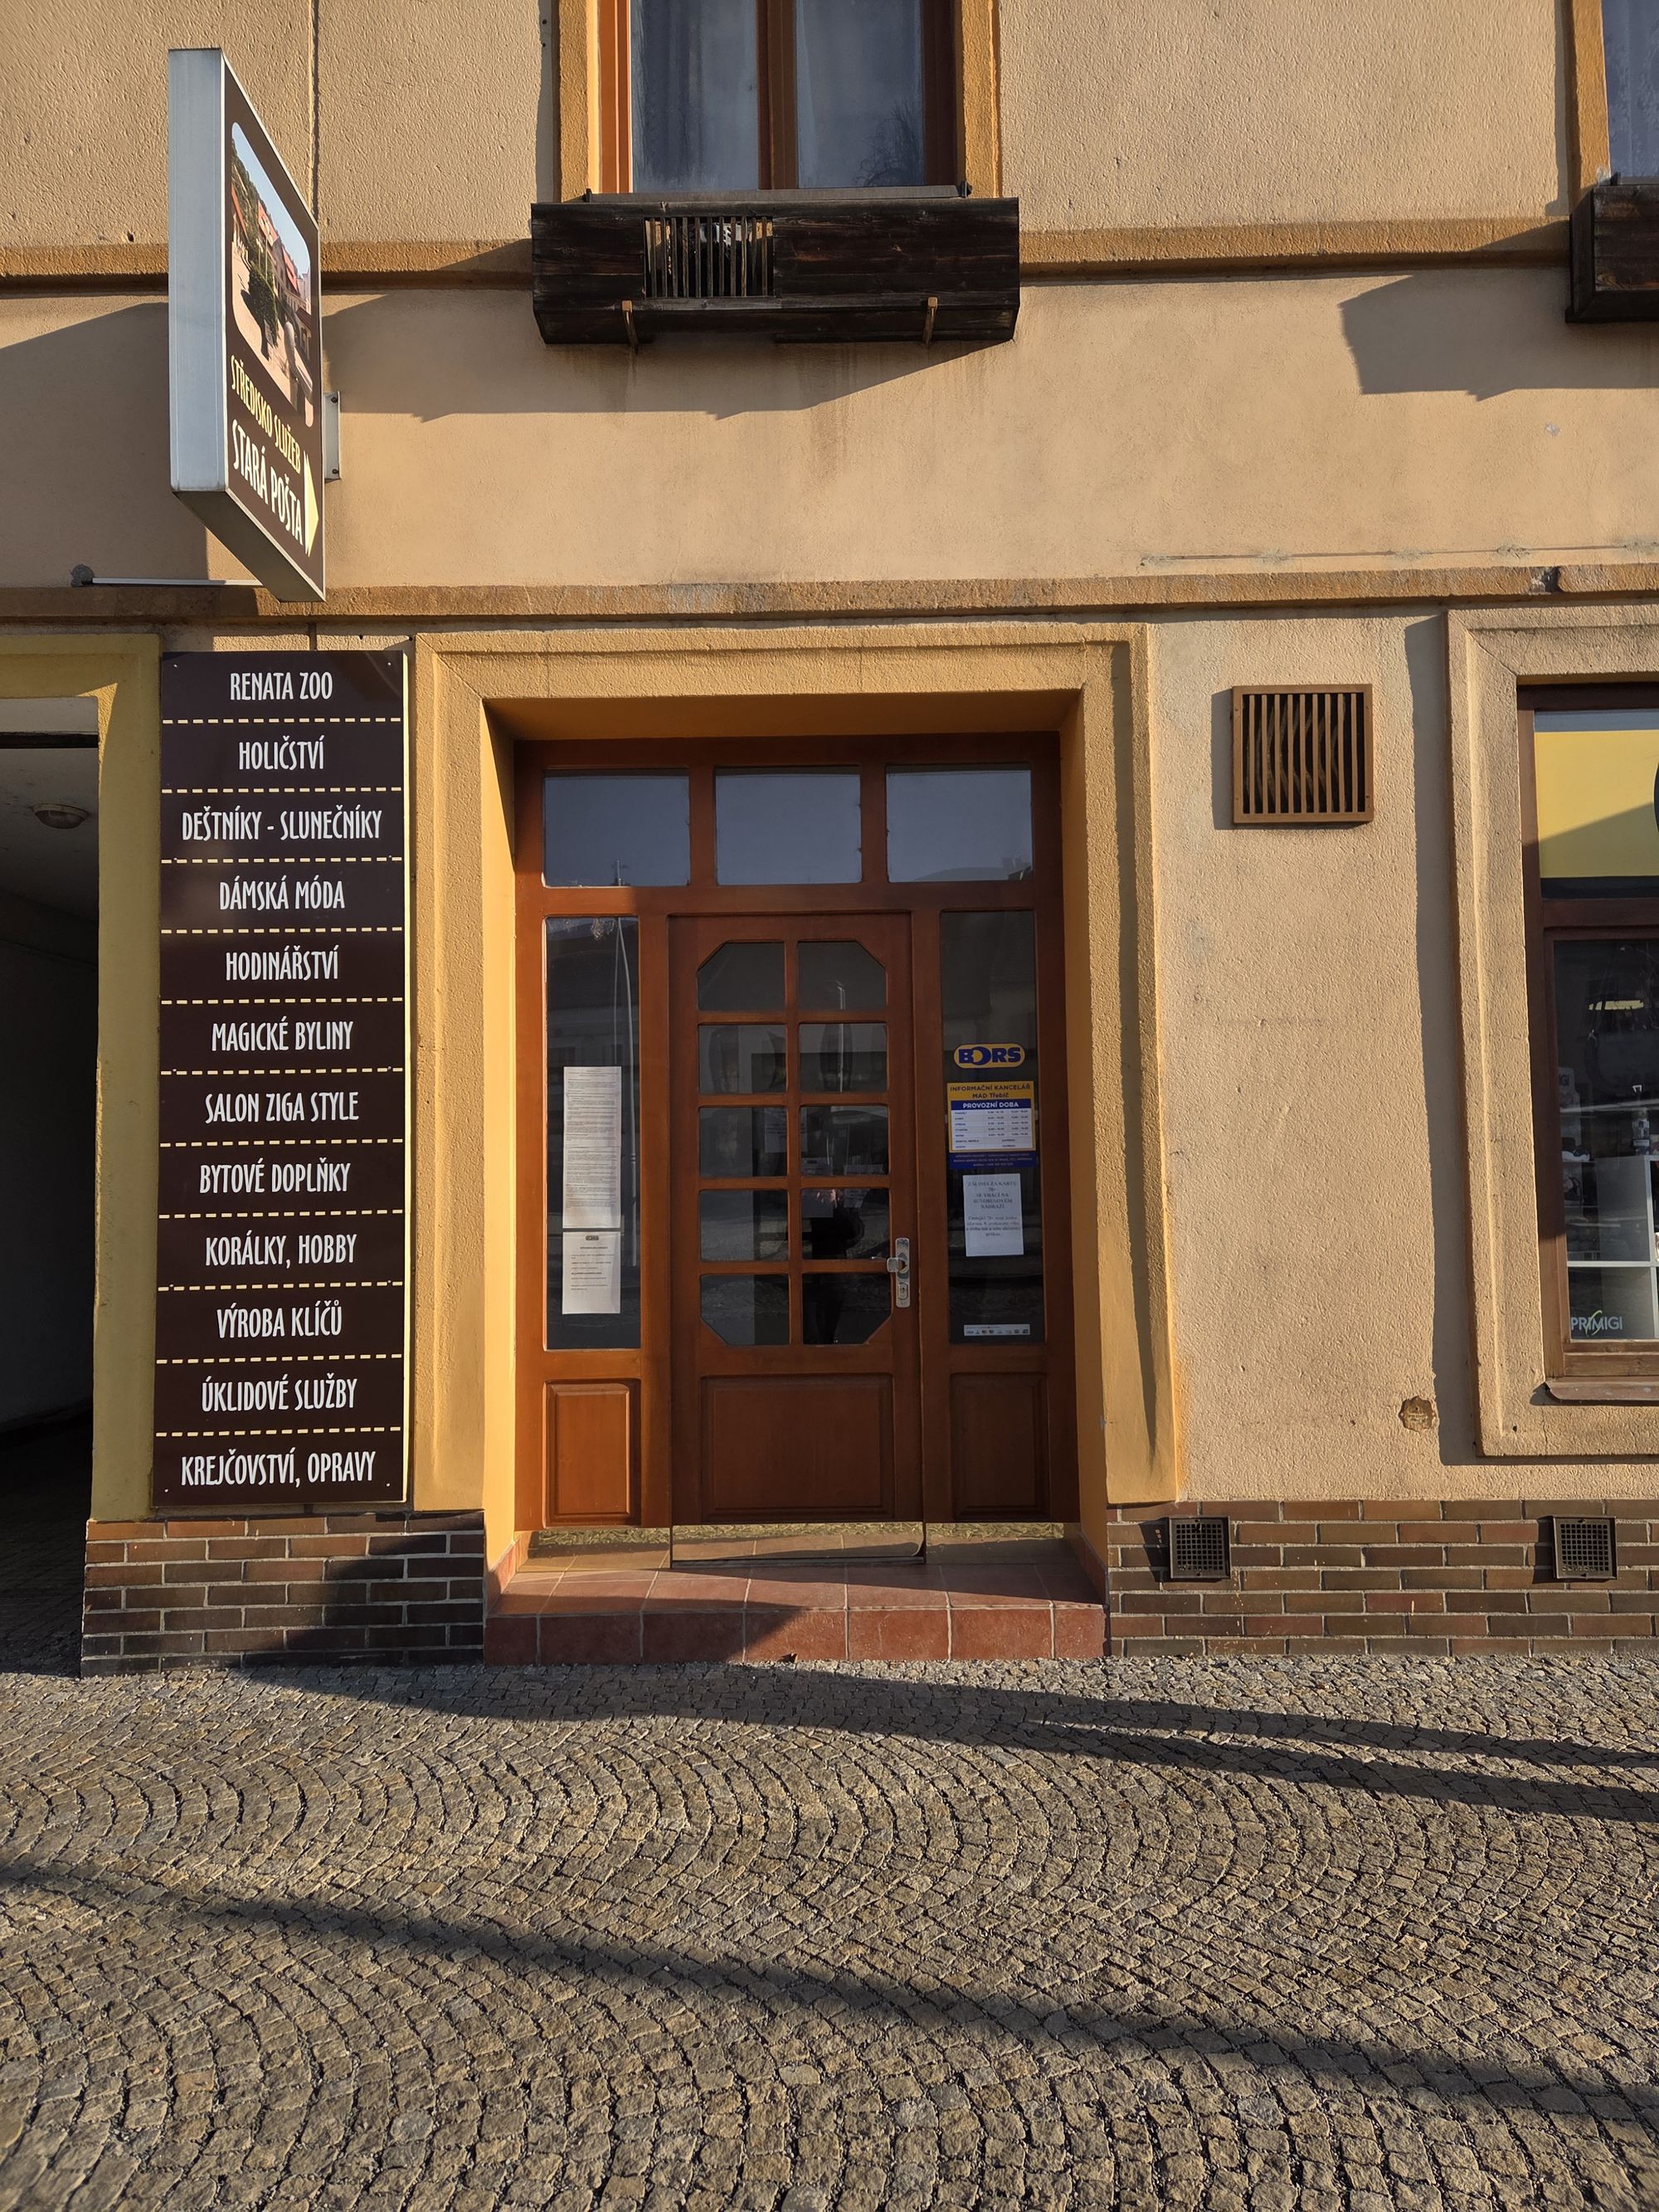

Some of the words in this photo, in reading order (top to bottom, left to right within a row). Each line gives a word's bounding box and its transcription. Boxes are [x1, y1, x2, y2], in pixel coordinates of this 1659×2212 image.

[231, 354, 273, 438] STŘEDISKO
[274, 414, 301, 475] SLUŽEB
[231, 418, 269, 505] STARÁ
[270, 466, 304, 547] POŠTA
[230, 671, 294, 701] RENATA
[299, 671, 333, 700] ZOO
[239, 734, 325, 771] HOLIČSTVÍ
[182, 805, 262, 842] DEŠTNÍKY
[280, 804, 382, 841] SLUNEČNÍKY
[219, 875, 289, 911] DÁMSKÁ
[294, 874, 346, 909] MÓDA
[226, 944, 339, 982] HODINÁŘSTVÍ
[212, 1015, 289, 1052] MAGICKÉ
[294, 1021, 354, 1050] BYLINY
[958, 1046, 1022, 1066] BORS
[950, 1084, 993, 1092] INFORMAČNÍ
[205, 1093, 260, 1124] SALON
[265, 1092, 305, 1122] ZIGA
[310, 1091, 359, 1123] STYLE
[199, 1157, 265, 1194] BYTOVÉ
[271, 1157, 351, 1193] DOPLŇKY
[205, 1229, 291, 1269] KORÁLKY,
[298, 1234, 358, 1264] HOBBY
[216, 1302, 285, 1339] VÝROBA
[291, 1299, 343, 1337] KLÍČŮ
[1570, 1315, 1623, 1332] PRIMIGI
[202, 1373, 289, 1412] ÚKLIDOVÉ
[294, 1372, 358, 1411] SLUŽBY
[181, 1446, 300, 1488] KREJČOVSTVÍ,
[307, 1450, 377, 1484] OPRAVY
